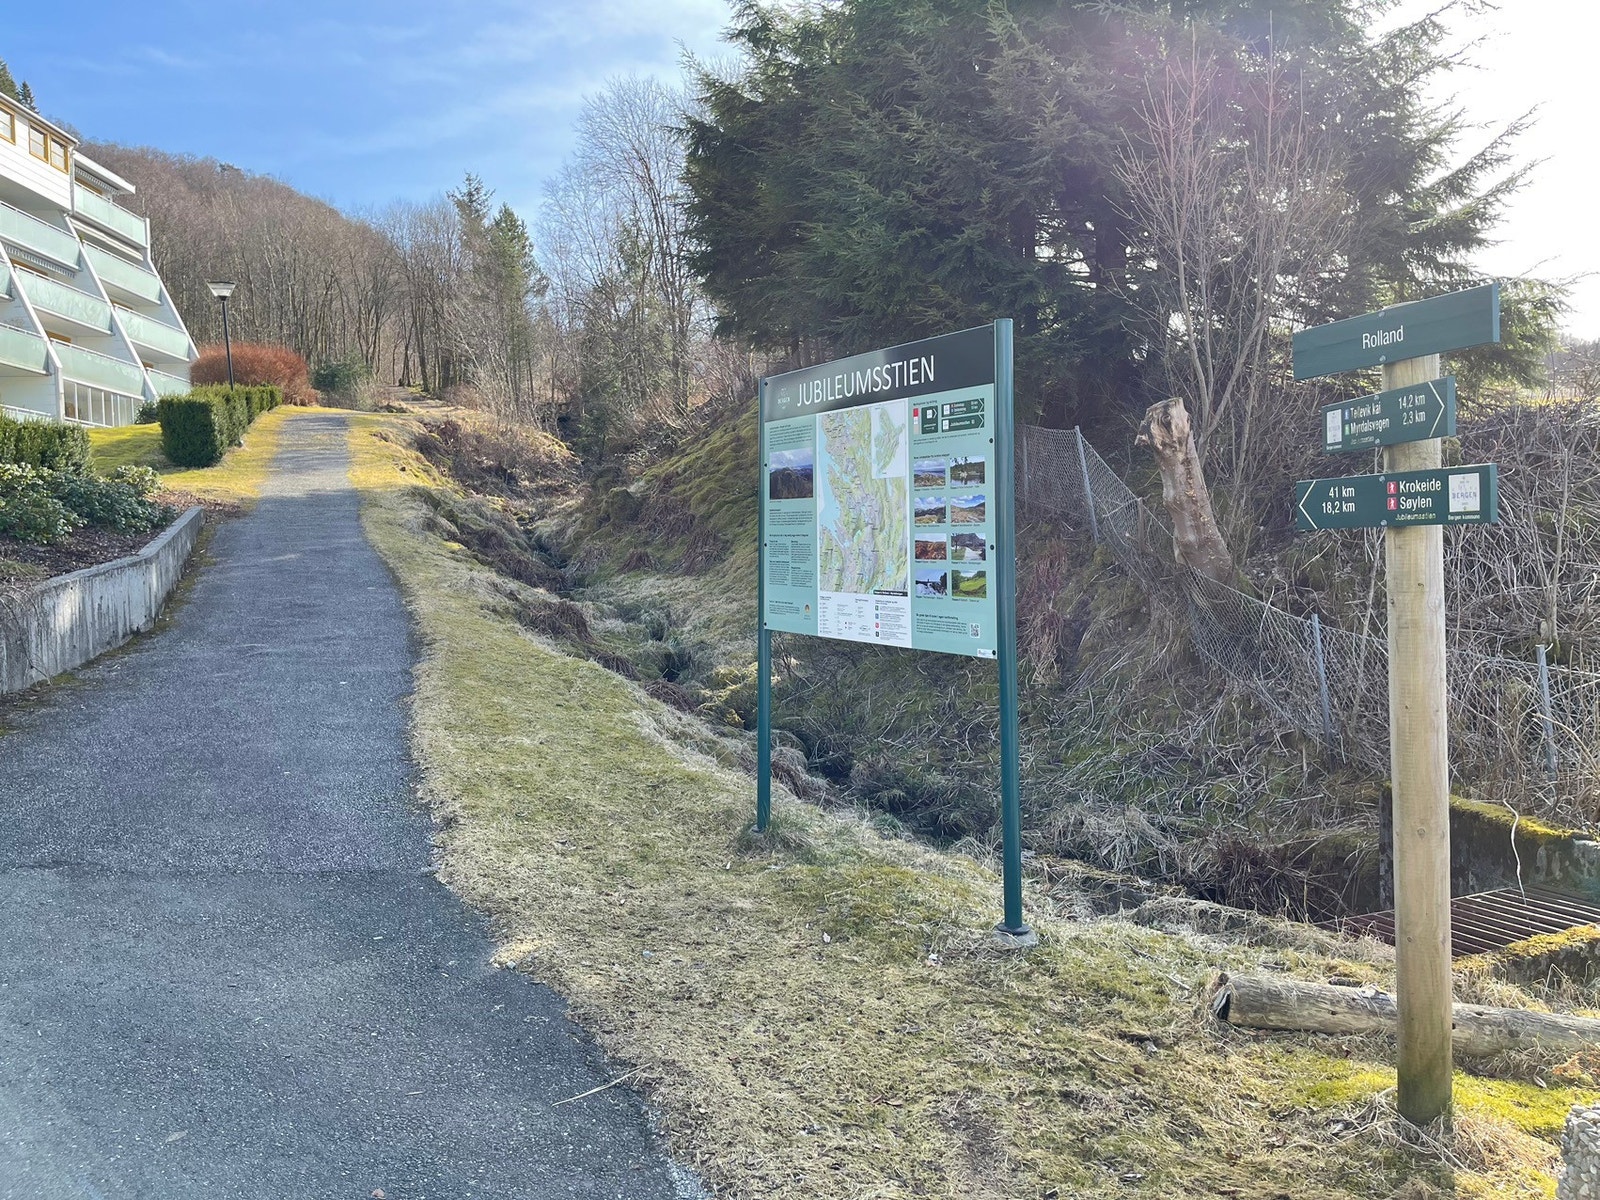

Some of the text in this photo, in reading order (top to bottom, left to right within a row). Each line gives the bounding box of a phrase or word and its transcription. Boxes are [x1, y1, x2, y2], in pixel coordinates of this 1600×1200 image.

[1362, 325, 1404, 350] Rolland
[796, 355, 935, 408] JUBILEUMSSTIEN
[1398, 395, 1413, 410] 14,2
[1415, 394, 1426, 406] km
[1350, 410, 1426, 436] Myrdalsvegen 2,3 km
[1329, 478, 1442, 498] 41 km Krokeide
[1321, 496, 1432, 515] 18,2 km Søylen
